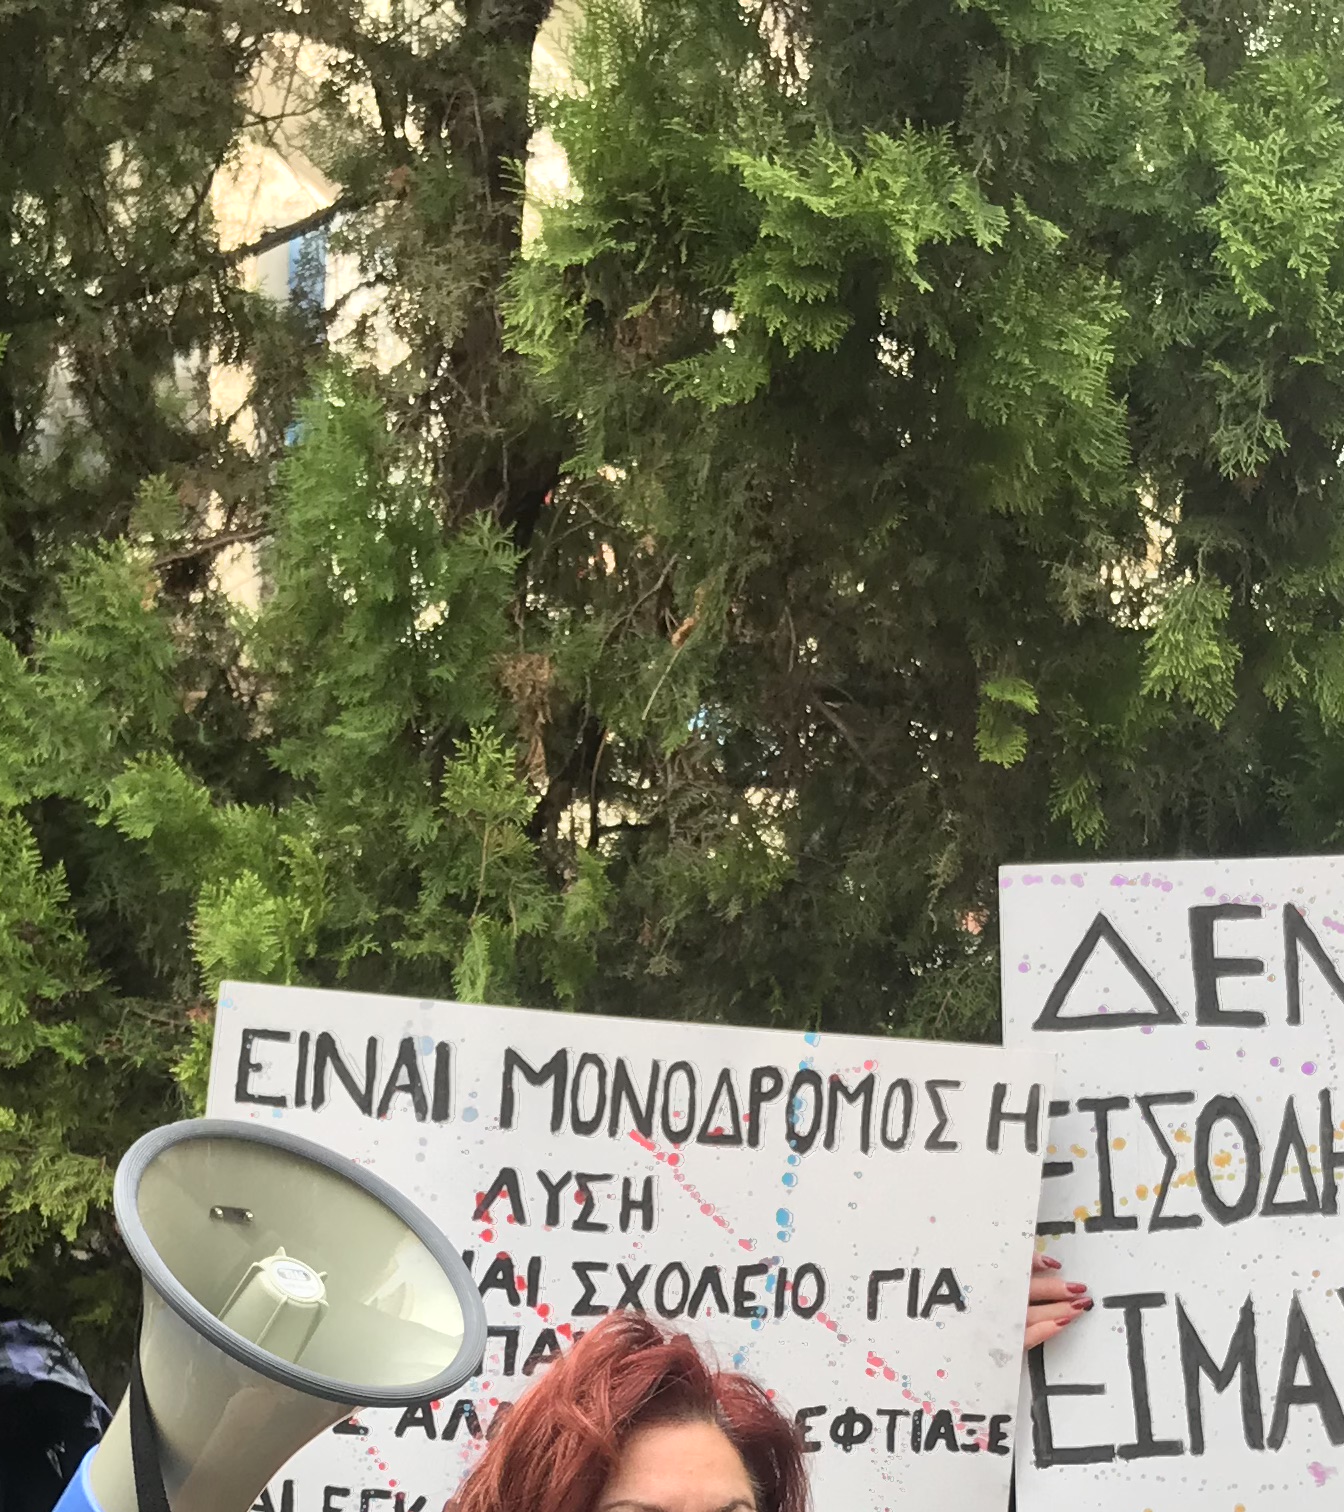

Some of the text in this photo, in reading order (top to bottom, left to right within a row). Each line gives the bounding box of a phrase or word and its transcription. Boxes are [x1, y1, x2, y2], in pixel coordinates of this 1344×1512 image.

[235, 1029, 1039, 1154] ΕΙΝΑΙ ΜΟΝΟΔΡΟΜΟΣ Η
[472, 1167, 654, 1232] ΛΥΣΗ
[571, 1261, 825, 1320] ΣΧΟΛΕΙΟ
[868, 1268, 966, 1320] ΓΙΑ
